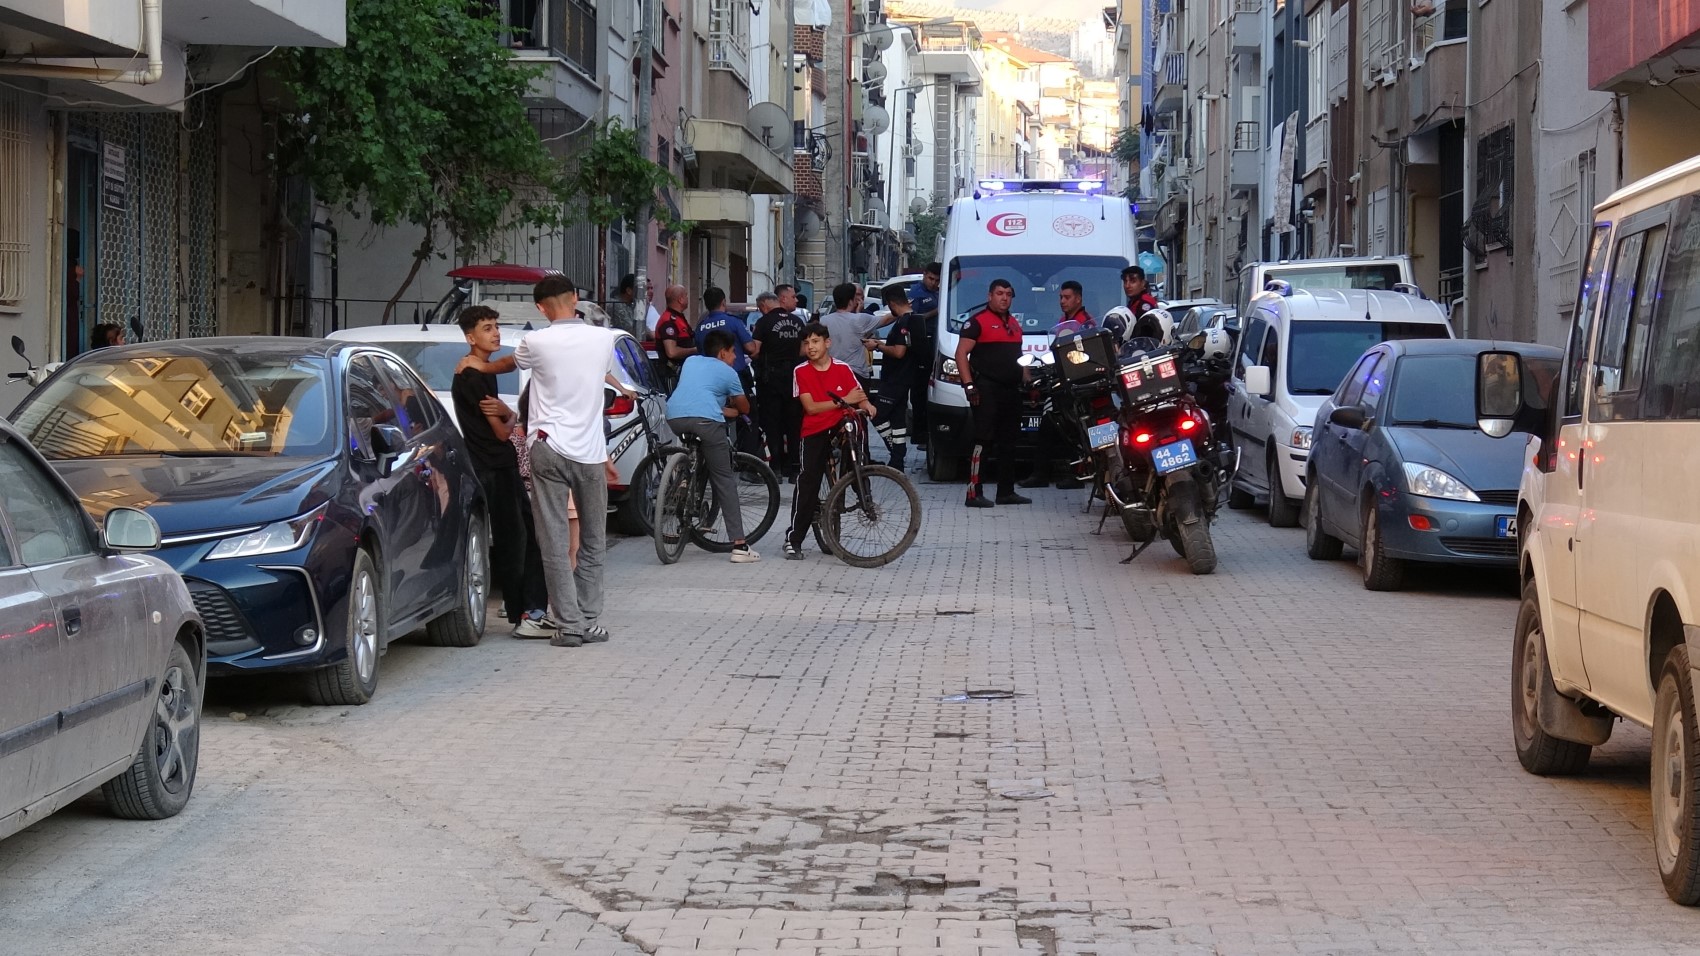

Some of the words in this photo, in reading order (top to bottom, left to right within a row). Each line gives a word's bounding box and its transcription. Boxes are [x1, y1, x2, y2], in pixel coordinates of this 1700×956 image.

[1160, 360, 1174, 373] 112
[1125, 371, 1140, 382] 112
[1091, 428, 1101, 437] 44
[1109, 424, 1115, 432] A
[1156, 448, 1171, 459] 44
[1181, 443, 1189, 453] A
[1161, 452, 1191, 468] 4862
